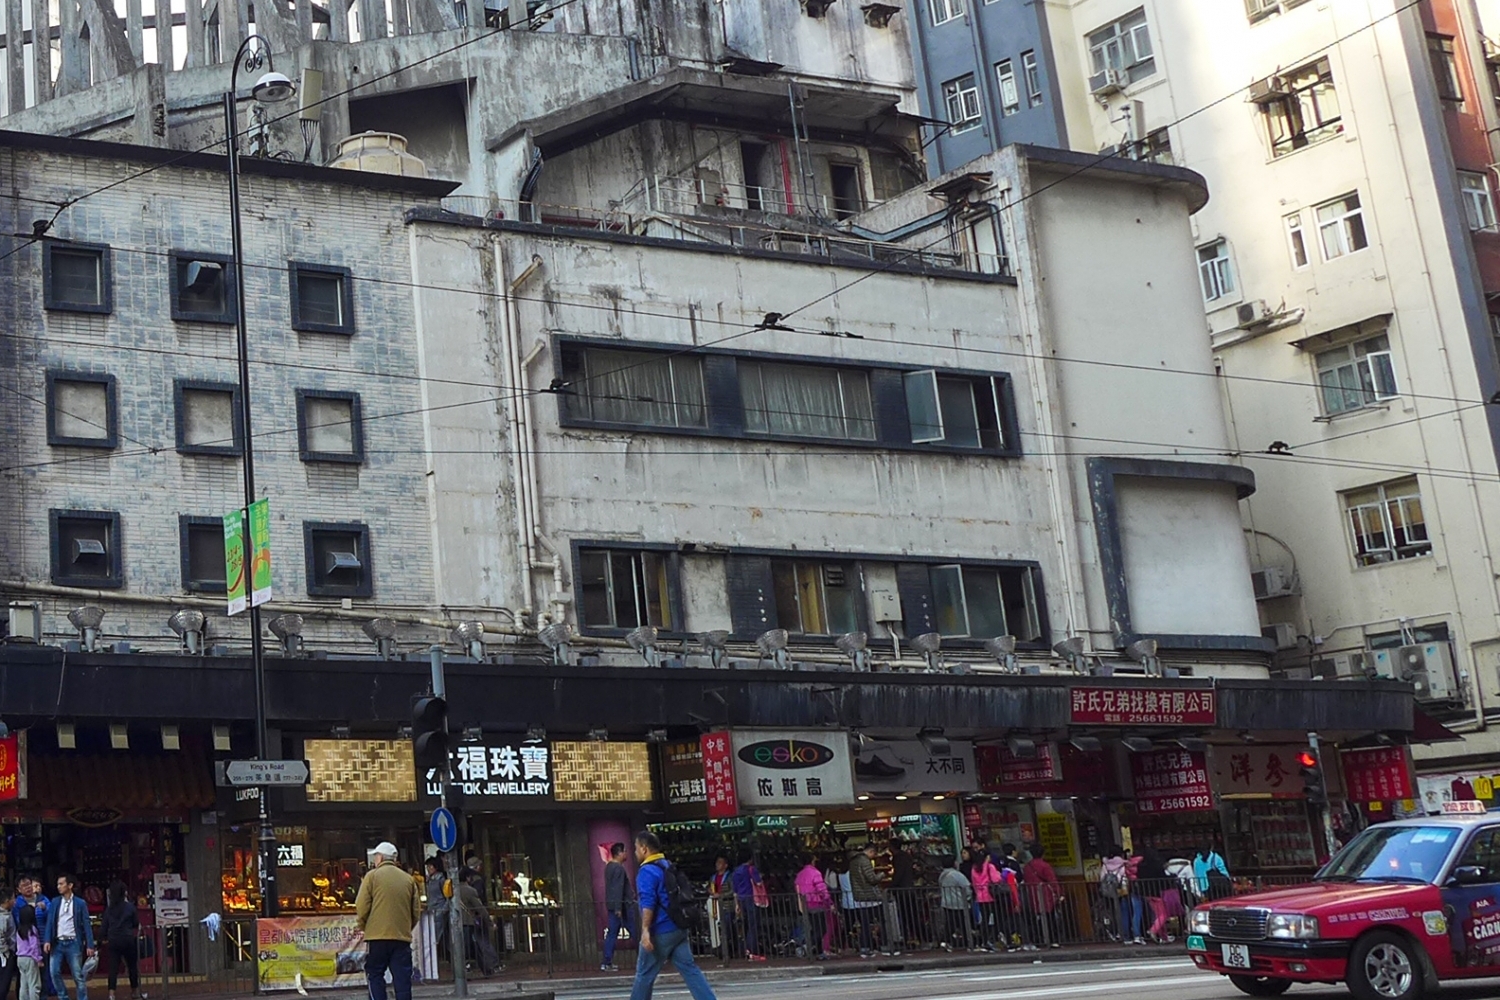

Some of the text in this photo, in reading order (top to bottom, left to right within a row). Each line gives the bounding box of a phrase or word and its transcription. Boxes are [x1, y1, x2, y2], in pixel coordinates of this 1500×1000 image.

[1072, 690, 1214, 714] 許氏兄弟找換有限公司
[1128, 714, 1184, 723] 25661592
[753, 739, 819, 763] esko
[926, 757, 966, 775] 大不同
[1142, 751, 1193, 772] 許氏兄弟
[427, 782, 551, 795] LUOK JEWELLERY
[757, 778, 822, 796] 依斯高
[1160, 795, 1210, 811] 25661592
[757, 816, 788, 827] Clarks
[277, 845, 304, 860] 六福
[1476, 899, 1490, 909] AIA
[1228, 955, 1245, 967] 492
